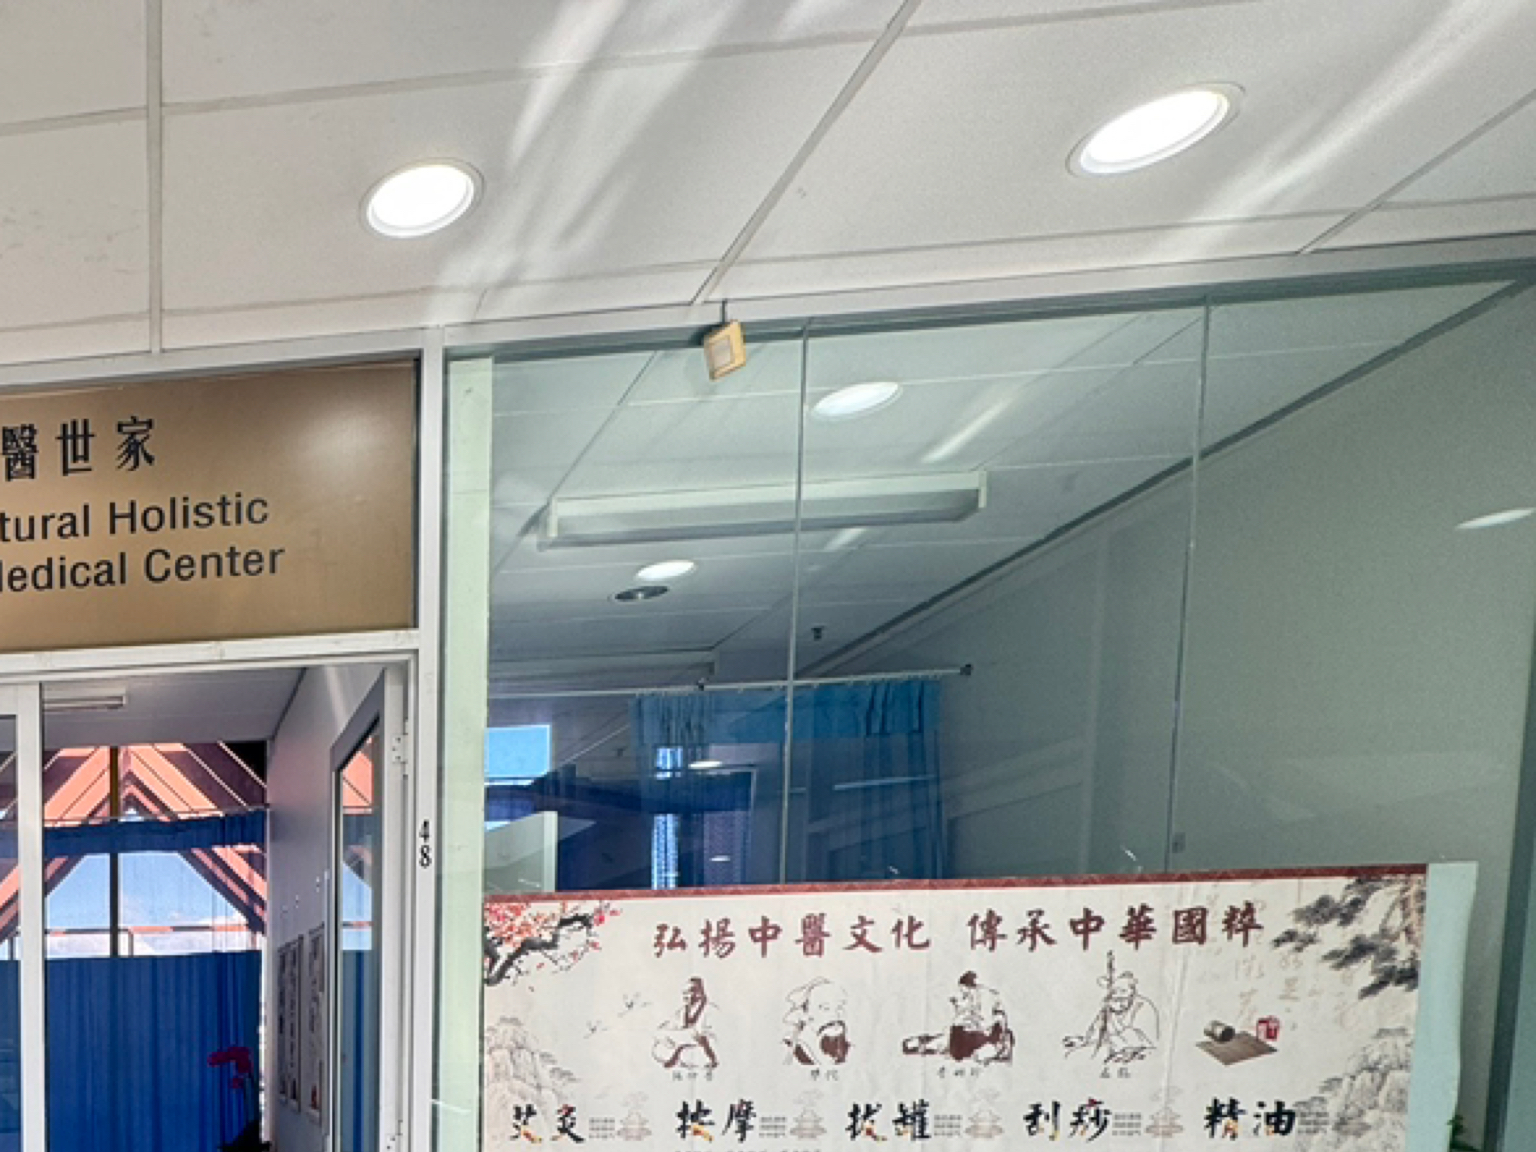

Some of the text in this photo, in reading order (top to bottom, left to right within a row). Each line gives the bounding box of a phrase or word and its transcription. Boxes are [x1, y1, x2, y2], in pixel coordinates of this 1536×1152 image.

[109, 492, 270, 536] Holistic
[144, 544, 285, 583] Center
[418, 819, 433, 869] 48
[654, 913, 931, 959] 弘揚中醫文化
[675, 1098, 757, 1142] 按摩
[1023, 1097, 1112, 1142] 刮痧
[1204, 1097, 1296, 1141] 精油
